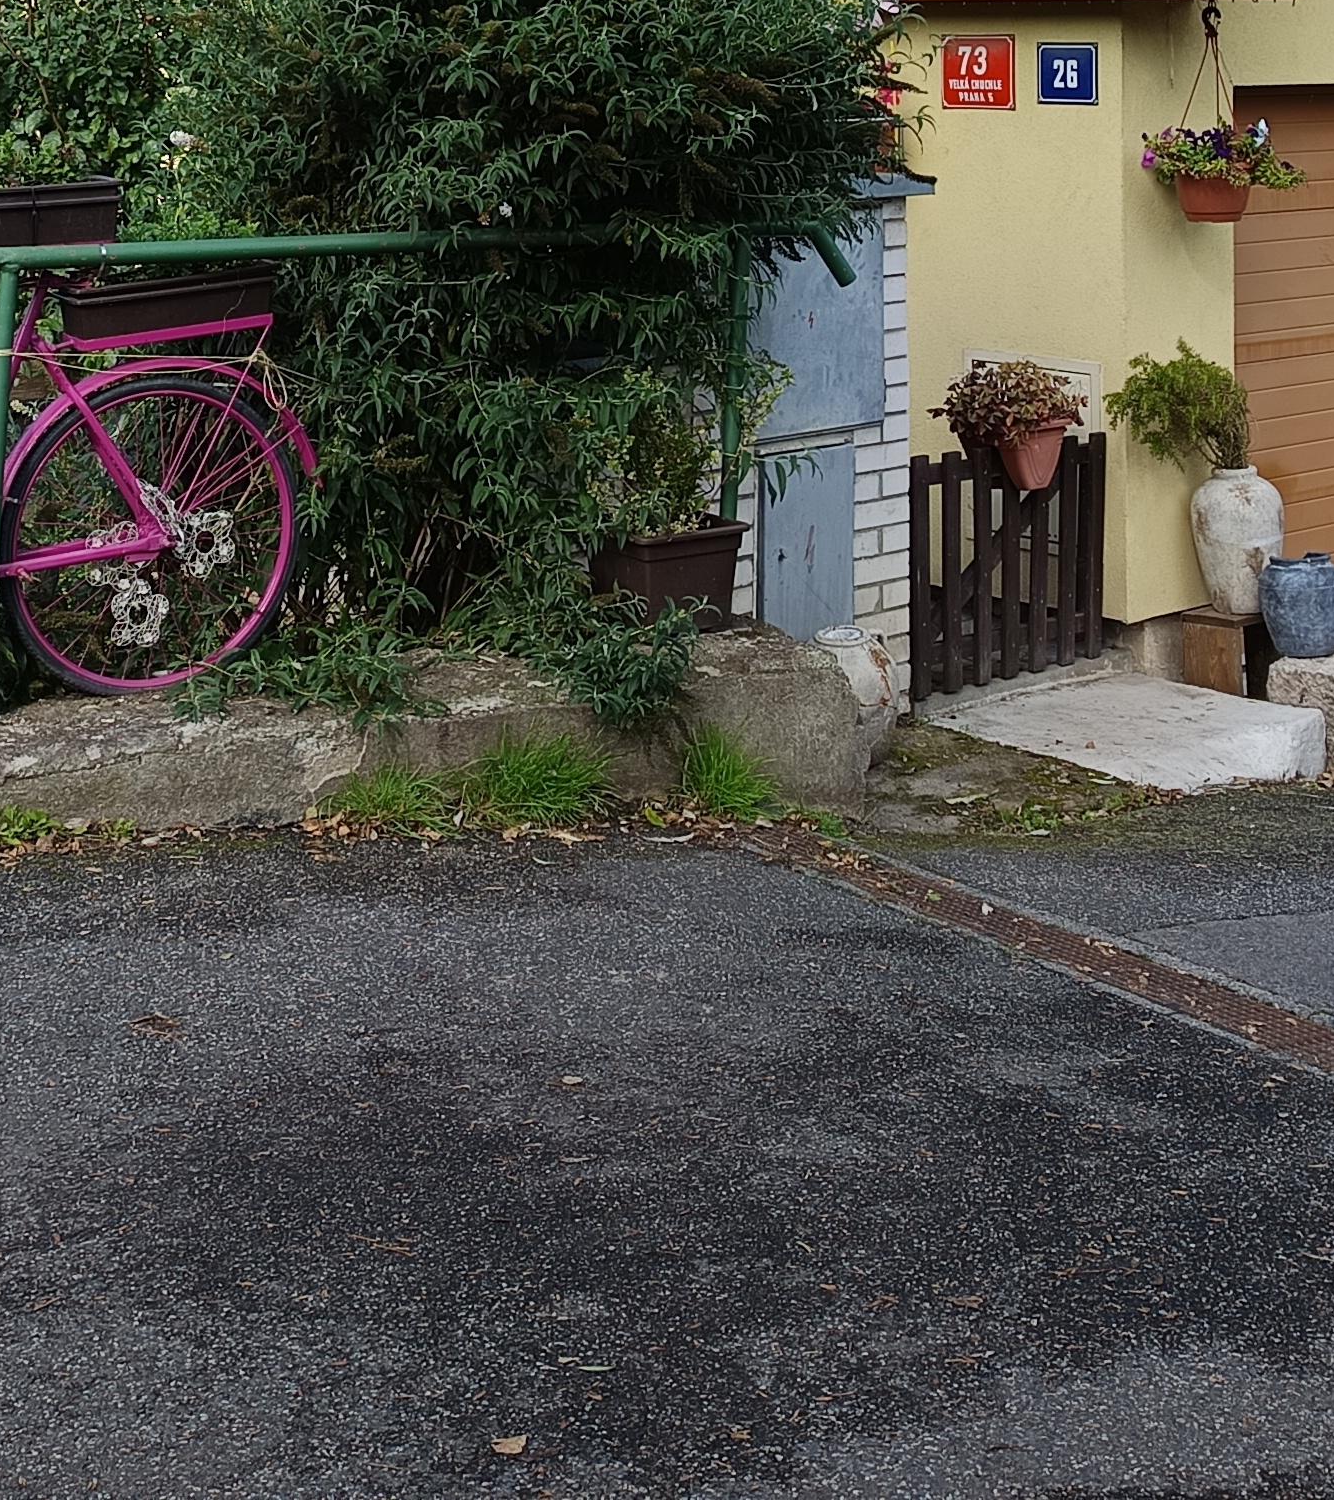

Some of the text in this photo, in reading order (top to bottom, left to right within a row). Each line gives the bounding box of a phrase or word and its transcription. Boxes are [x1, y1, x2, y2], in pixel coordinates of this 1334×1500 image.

[958, 46, 988, 76] 73
[948, 76, 1003, 91] VELKÁ CHUCHLE
[1053, 59, 1078, 89] 26
[958, 91, 994, 103] PRAHA 5
